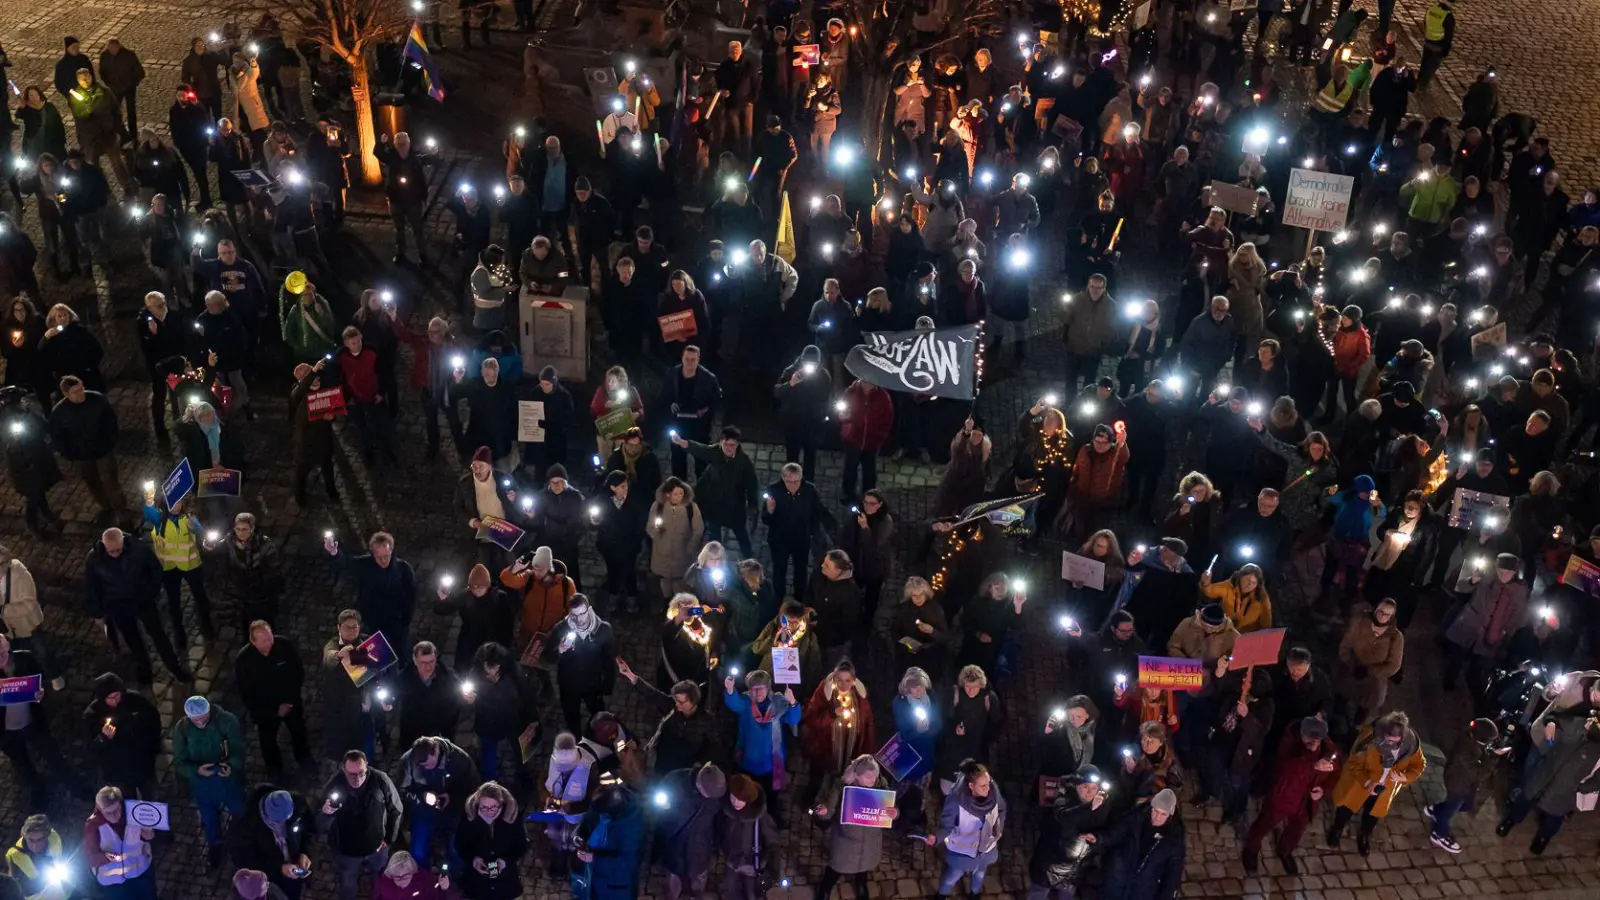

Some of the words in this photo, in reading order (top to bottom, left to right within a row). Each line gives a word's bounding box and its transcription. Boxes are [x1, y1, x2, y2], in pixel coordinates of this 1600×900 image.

[1320, 193, 1347, 213] keine
[1145, 660, 1163, 672] NIE
[1168, 664, 1203, 674] WIEDER
[1148, 675, 1165, 685] IST
